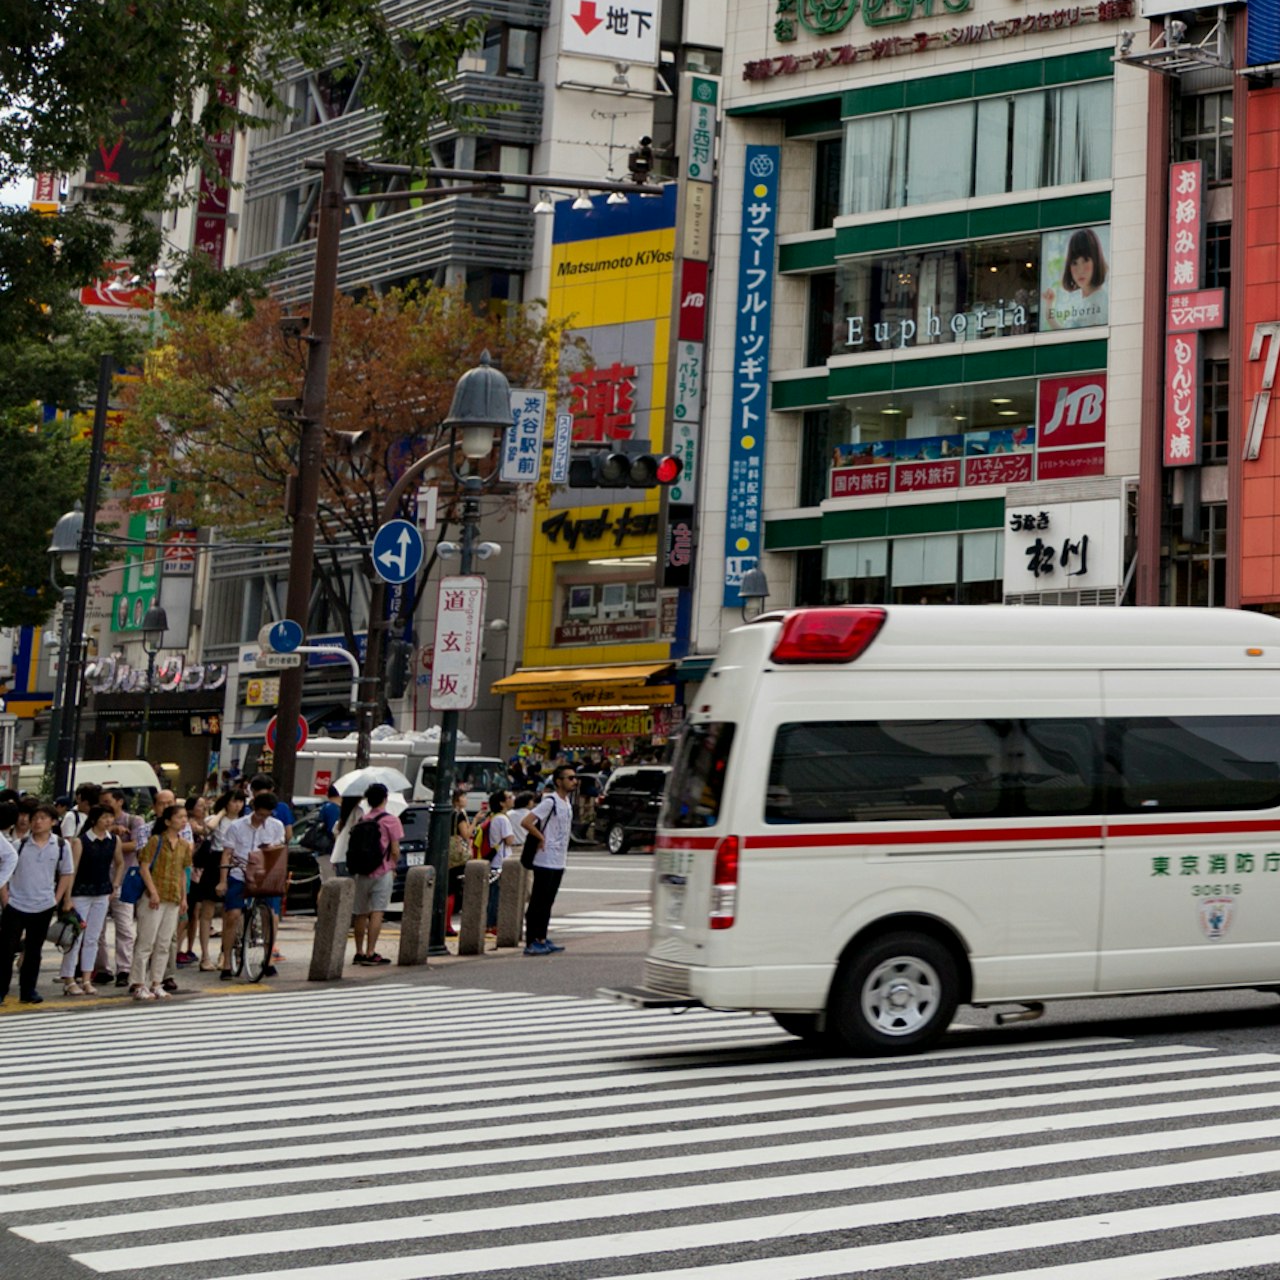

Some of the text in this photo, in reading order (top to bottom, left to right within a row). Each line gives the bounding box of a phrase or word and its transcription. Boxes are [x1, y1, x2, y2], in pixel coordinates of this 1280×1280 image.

[605, 7, 652, 38] 地下
[1173, 169, 1196, 284] お好み焼
[557, 254, 632, 276] Matsumoto
[682, 292, 704, 307] JTB
[739, 201, 771, 430] サマーフルーツギフト
[1047, 304, 1102, 320] Euphoria
[845, 298, 1027, 347] Euphoria
[679, 363, 687, 402] パーラー
[689, 358, 699, 397] フルーツ
[1170, 338, 1192, 458] もんじゃ焼
[568, 362, 636, 442] 薬
[1044, 384, 1104, 436] JTB
[518, 397, 540, 474] 渋谷駅前
[834, 472, 887, 492] 国内旅行
[900, 467, 955, 486] 海外旅行
[971, 456, 1026, 471] ハネムーン
[745, 456, 759, 532] 無料配送地域
[1025, 534, 1089, 578] 松川
[438, 590, 464, 696] 道玄坂
[1192, 883, 1242, 896] 30616
